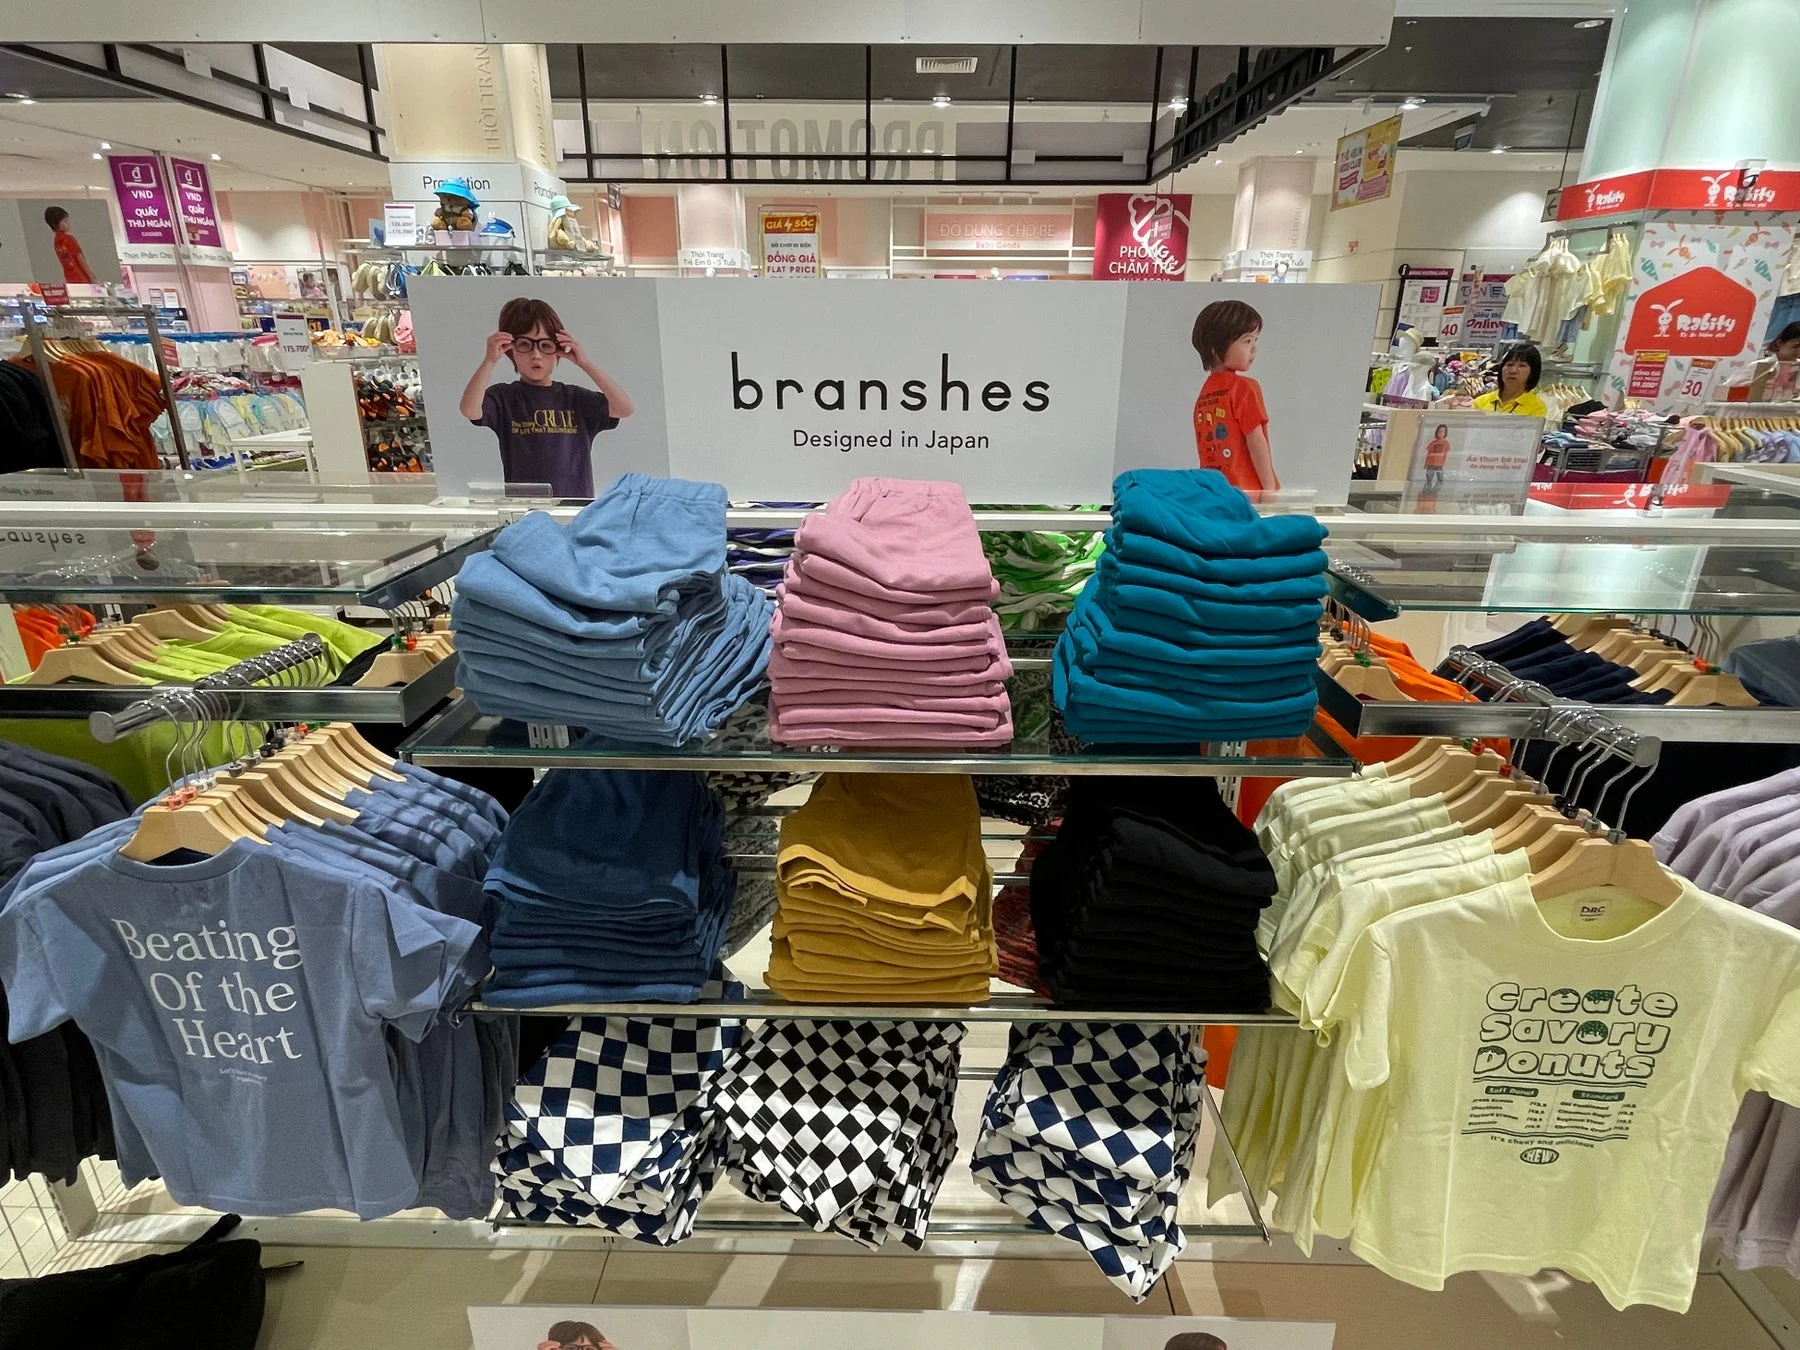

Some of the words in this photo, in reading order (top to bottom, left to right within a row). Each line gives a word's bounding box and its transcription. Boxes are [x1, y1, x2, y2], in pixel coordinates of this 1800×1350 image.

[422, 176, 491, 190] Protion
[131, 190, 153, 199] VND
[185, 191, 202, 202] VND
[127, 219, 145, 228] THU
[766, 219, 782, 229] GIÁ
[794, 215, 815, 228] SỐC
[1006, 223, 1037, 237] CHO
[766, 250, 796, 263] ĐỒNG
[798, 252, 817, 263] GIÁ
[1441, 323, 1458, 336] 40
[1676, 312, 1736, 333] Rabity
[731, 351, 1051, 412] branshes
[1681, 380, 1703, 397] 30
[793, 429, 892, 452] Designed
[901, 430, 918, 448] in
[925, 430, 989, 455] Japan
[111, 919, 304, 970] Beating
[150, 971, 207, 1012] Of
[218, 971, 297, 1016] the
[1486, 981, 1679, 1018] Create
[172, 1018, 302, 1065] Heart
[1479, 1012, 1671, 1055] Savory
[1473, 1045, 1656, 1079] Donuts
